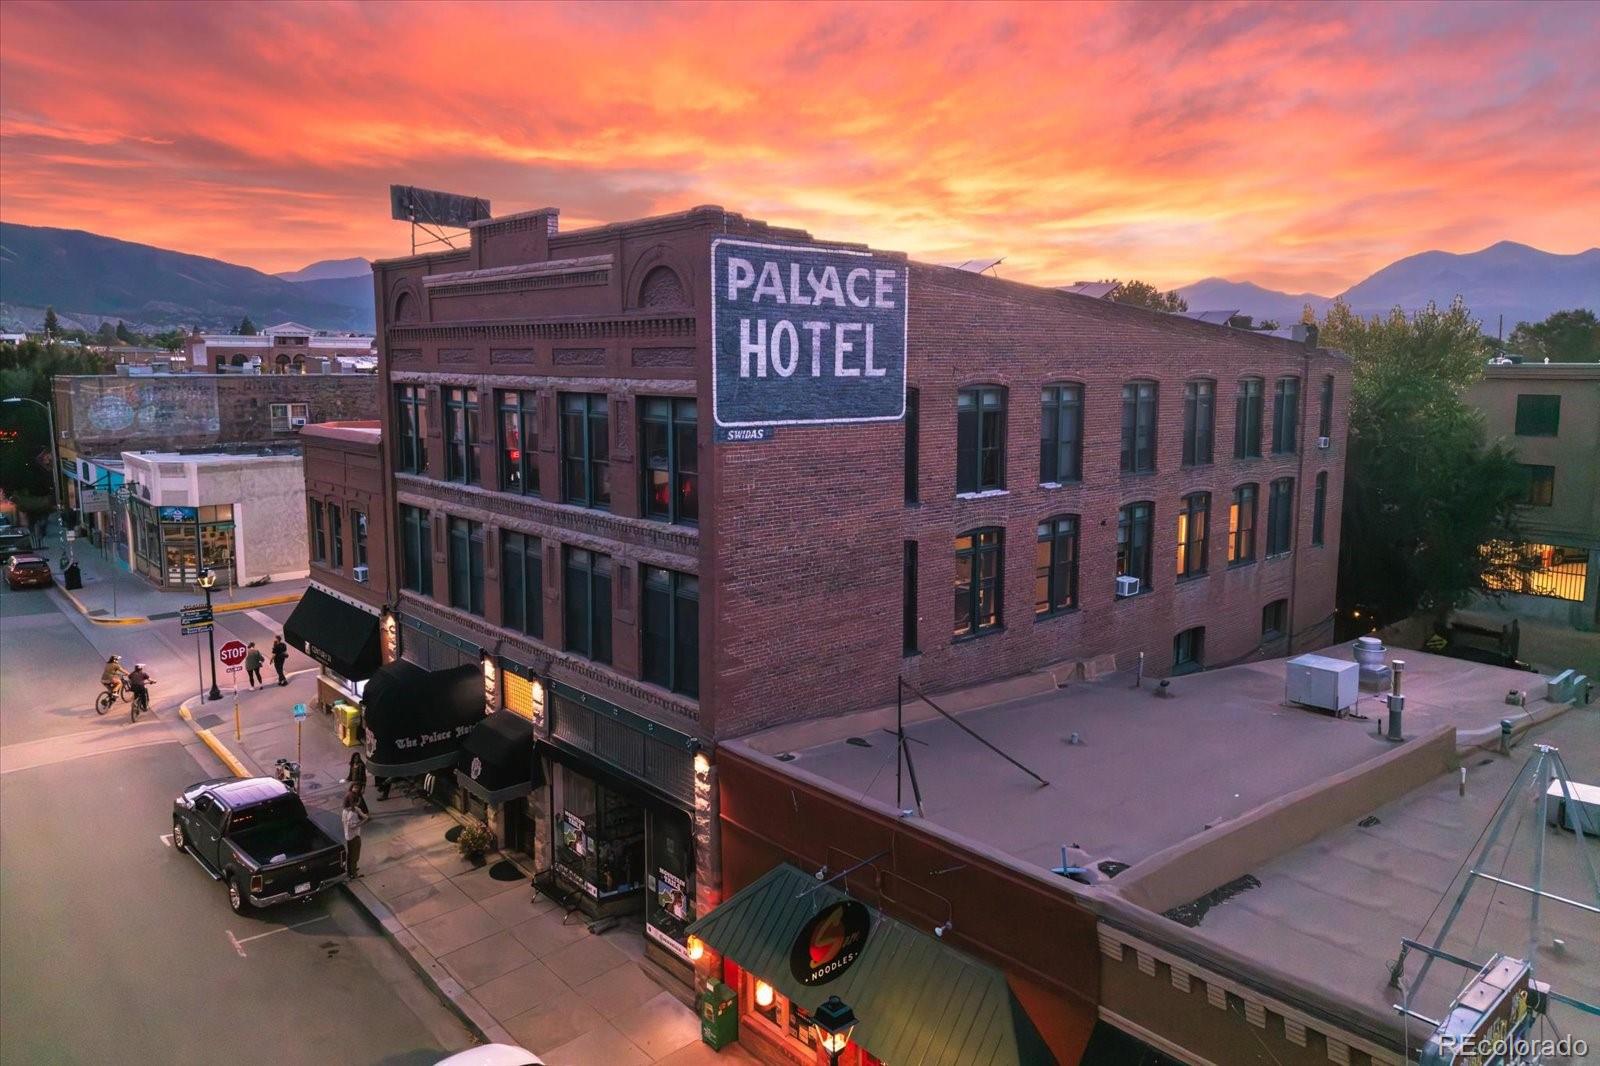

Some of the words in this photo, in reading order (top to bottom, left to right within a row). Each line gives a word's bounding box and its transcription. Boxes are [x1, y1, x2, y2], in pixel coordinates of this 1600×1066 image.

[727, 256, 897, 309] PALACE
[739, 318, 887, 378] HOTEL
[221, 647, 246, 661] STOP
[395, 738, 418, 750] The
[420, 731, 452, 747] Palace
[811, 953, 854, 981] NOODLES
